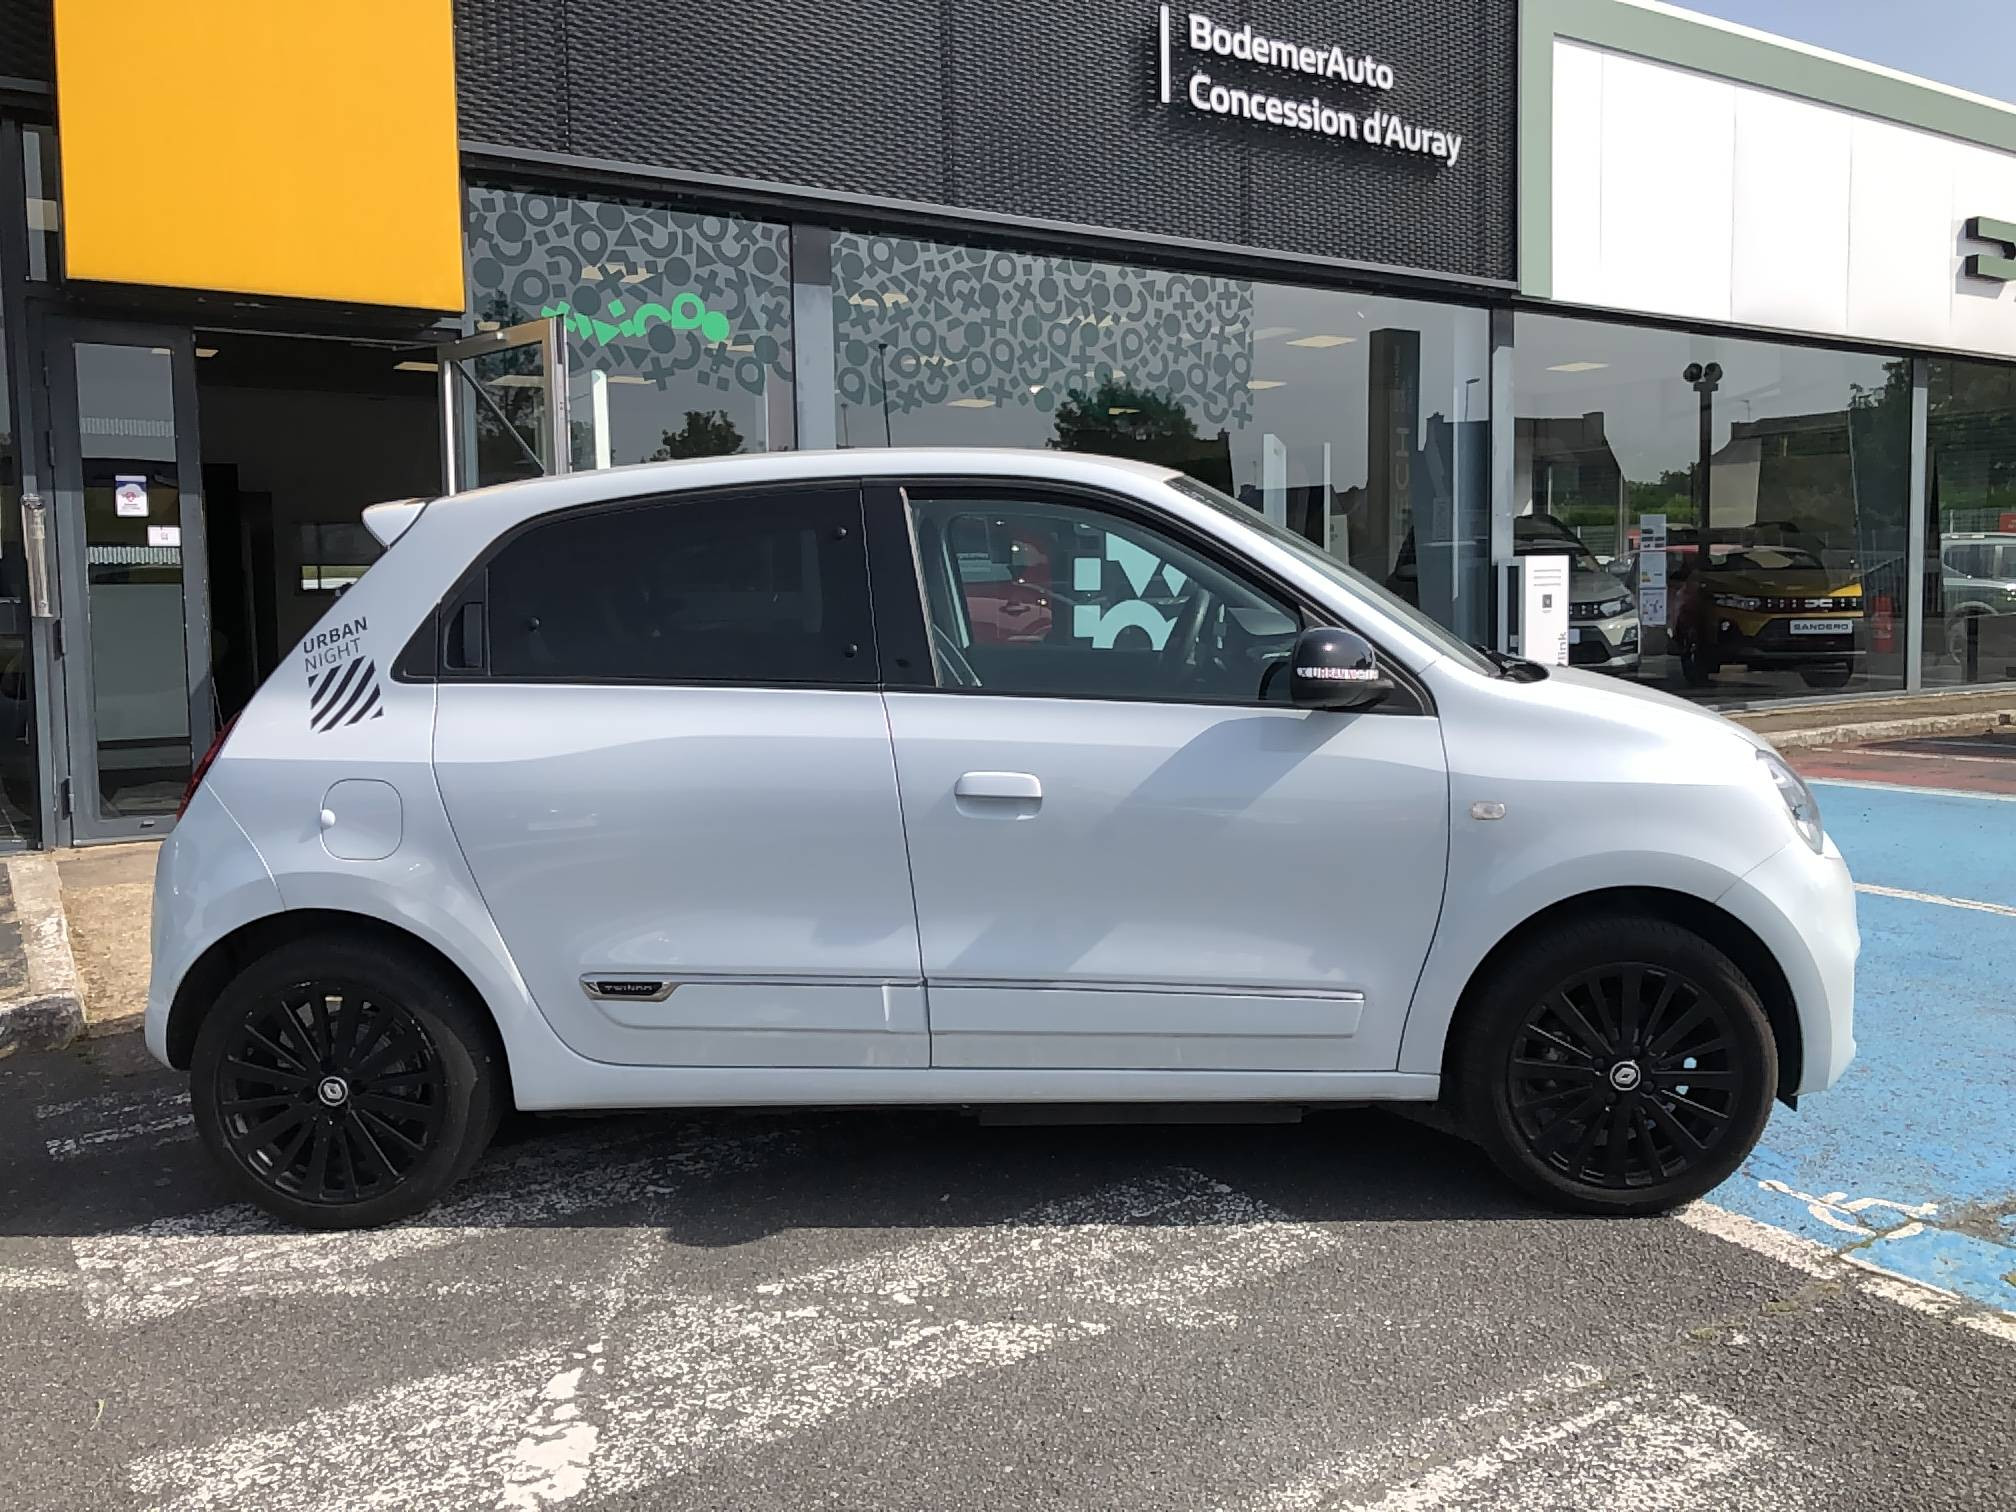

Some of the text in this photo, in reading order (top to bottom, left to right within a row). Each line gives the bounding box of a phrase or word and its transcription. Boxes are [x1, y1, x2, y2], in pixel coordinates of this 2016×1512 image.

[1188, 13, 1394, 91] BodemerAuto
[1188, 73, 1462, 168] Concession d'Auray
[303, 616, 368, 654] URBAN
[1793, 623, 1849, 631] SANDERO
[304, 637, 361, 673] NIGHT
